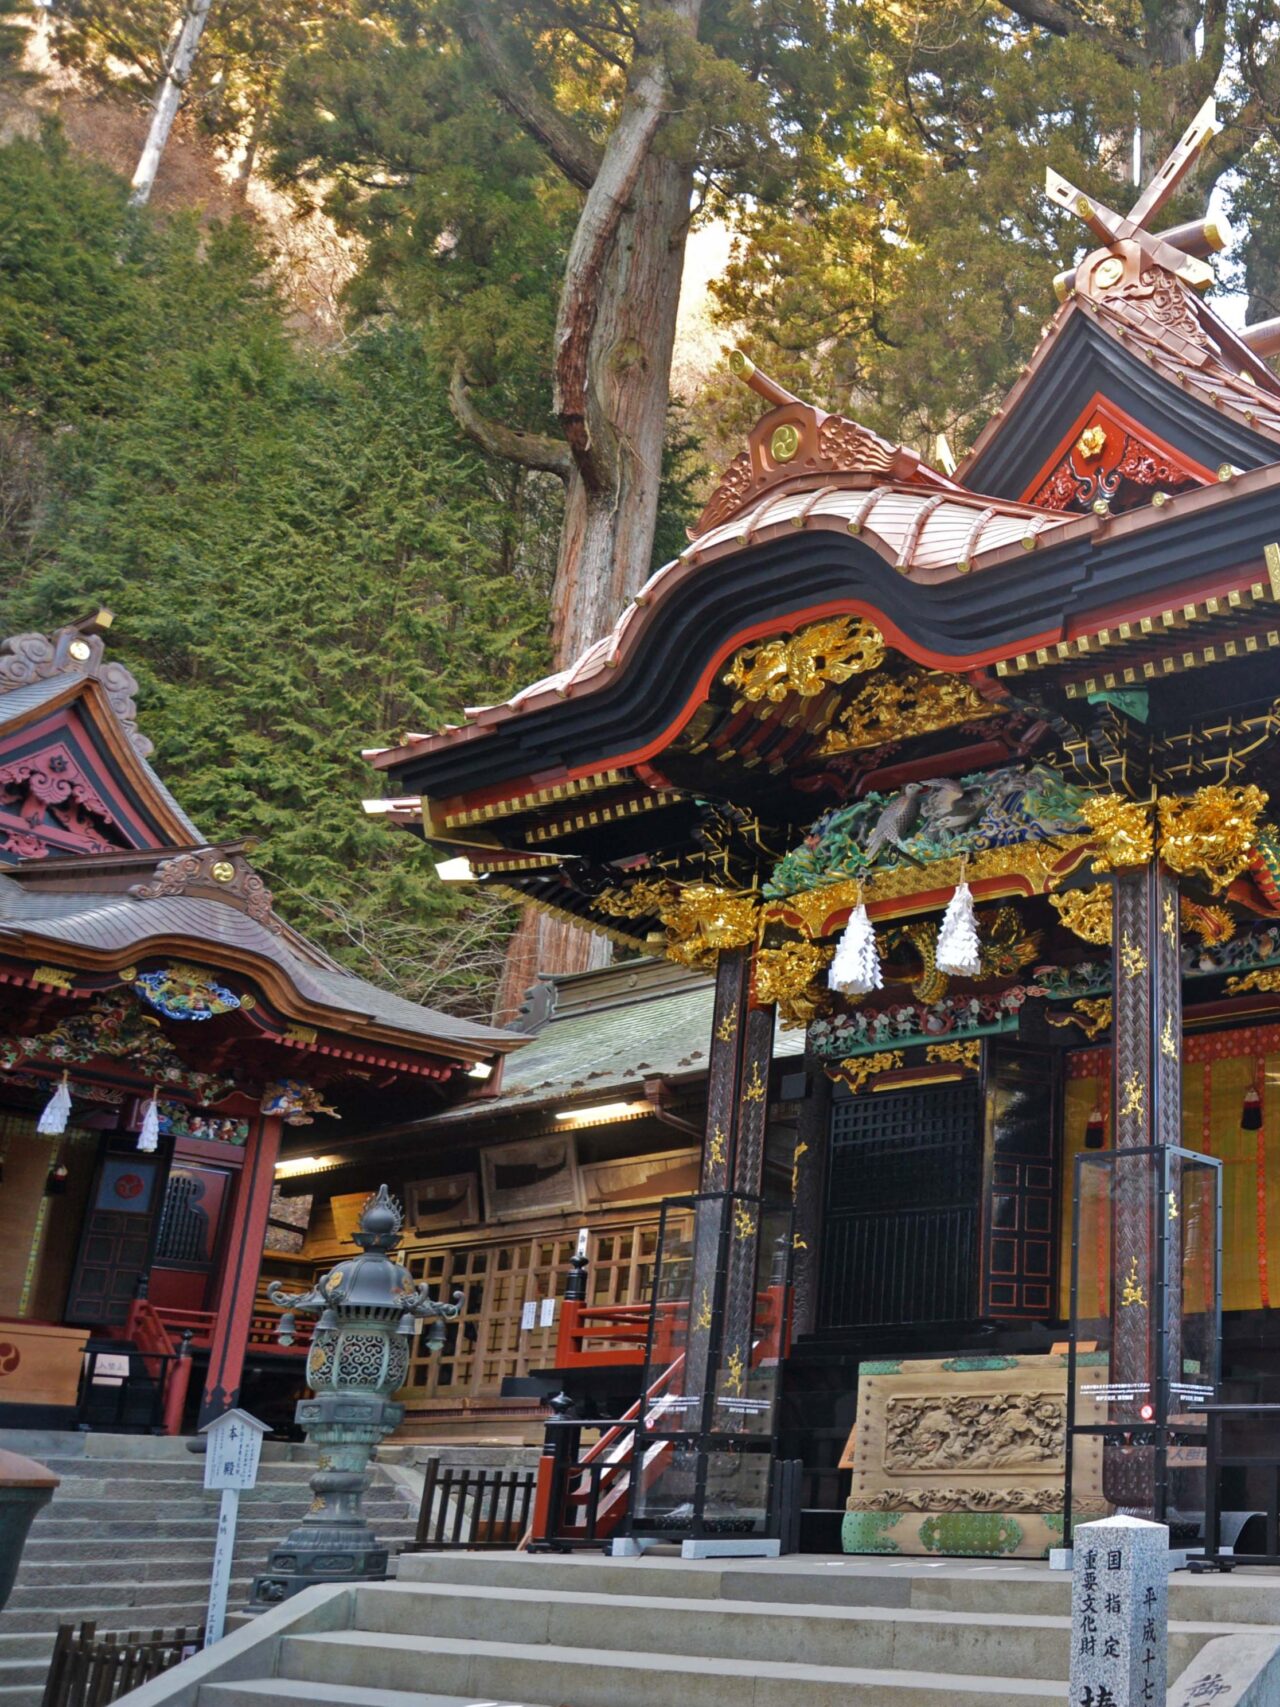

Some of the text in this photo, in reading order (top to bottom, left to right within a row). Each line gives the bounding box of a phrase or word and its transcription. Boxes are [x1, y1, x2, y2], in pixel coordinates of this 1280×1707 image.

[224, 1424, 238, 1475] 本殿
[1078, 1550, 1098, 1657] 重要文化財
[1102, 1549, 1122, 1659] 国指定
[1141, 1587, 1158, 1707] 平成十七
